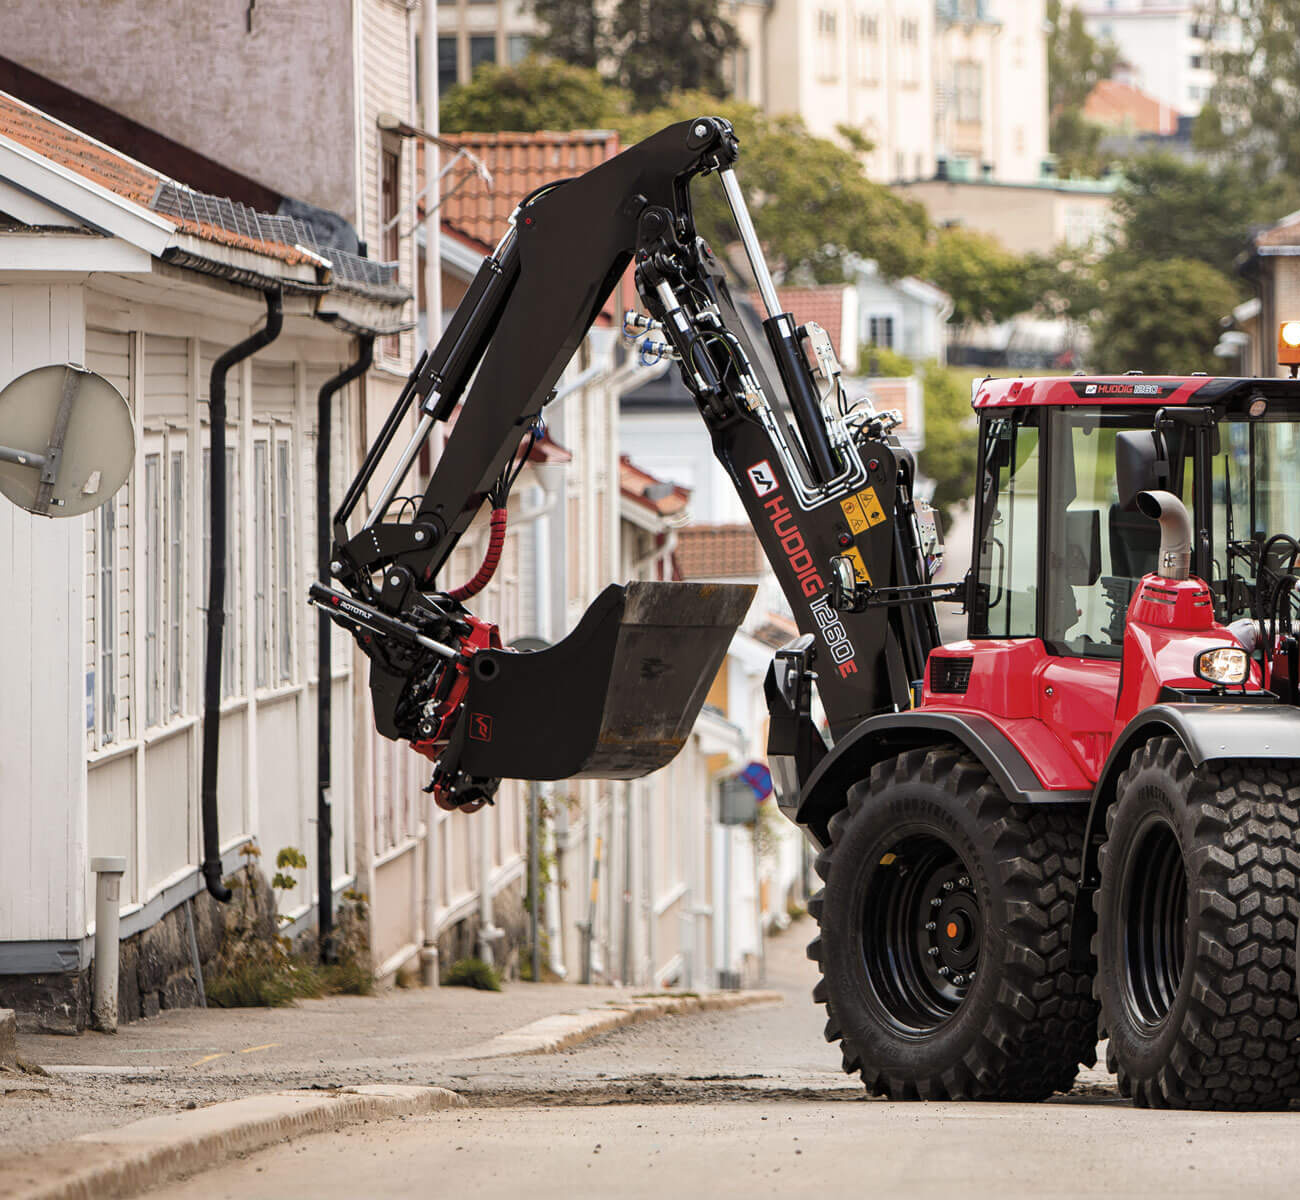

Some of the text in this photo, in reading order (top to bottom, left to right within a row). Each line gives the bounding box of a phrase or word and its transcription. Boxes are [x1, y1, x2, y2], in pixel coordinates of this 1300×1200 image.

[1097, 384, 1133, 393] HUDDIG
[764, 495, 858, 679] HUDDIG 1260E
[340, 600, 373, 619] ROTOTILT
